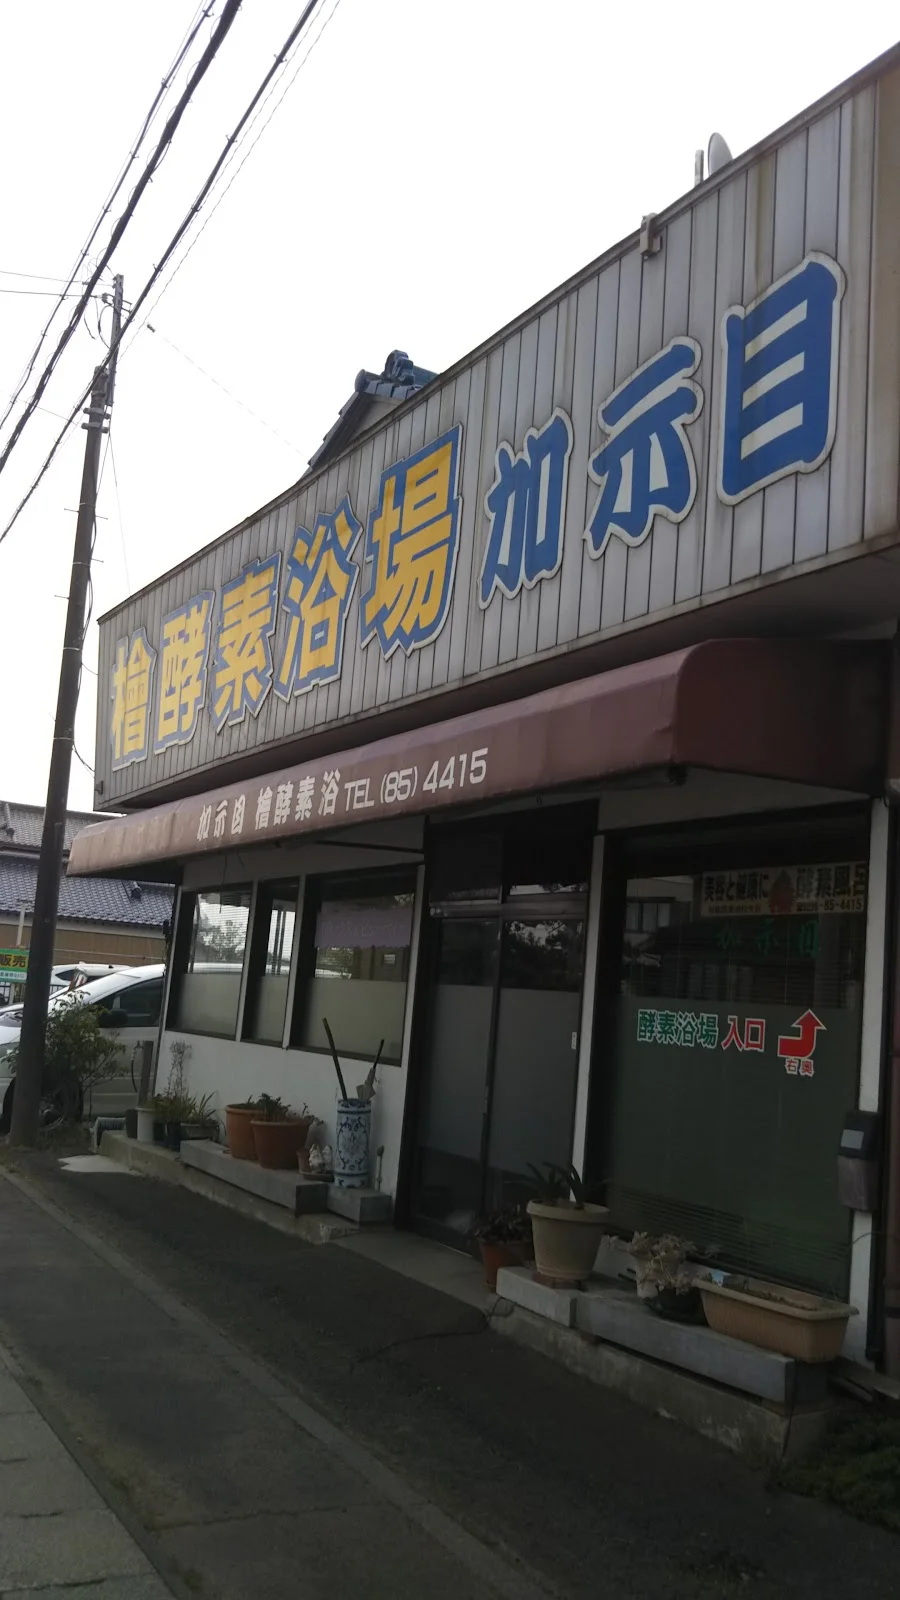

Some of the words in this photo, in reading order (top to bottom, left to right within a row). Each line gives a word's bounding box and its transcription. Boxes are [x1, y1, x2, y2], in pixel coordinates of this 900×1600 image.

[478, 252, 846, 611] 加示目
[344, 778, 375, 811] TEL
[380, 766, 418, 805] (85)
[423, 748, 488, 794] 4415
[721, 1015, 765, 1052] 入口
[785, 1058, 814, 1077] 右奥
